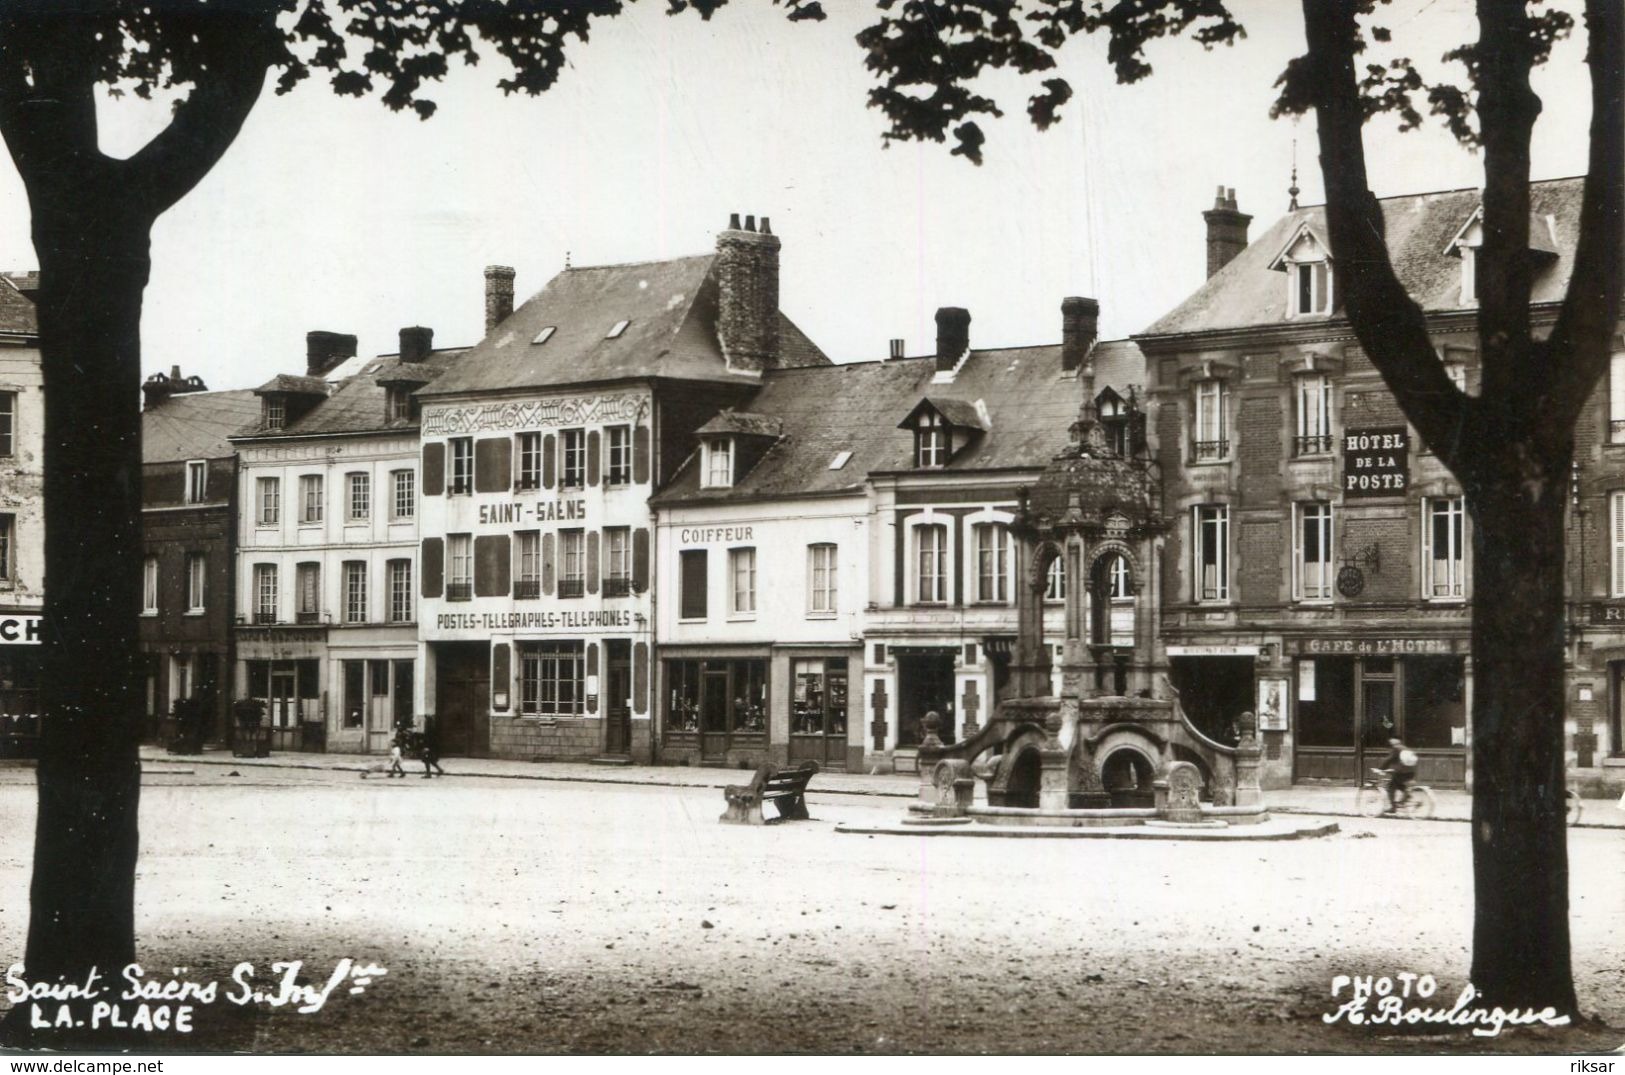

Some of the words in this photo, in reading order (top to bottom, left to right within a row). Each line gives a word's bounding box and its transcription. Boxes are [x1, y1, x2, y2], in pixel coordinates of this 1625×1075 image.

[1356, 457, 1372, 468] DE
[1378, 456, 1396, 467] LA
[1347, 474, 1404, 490] POSTE
[681, 526, 753, 544] COIFFEUR
[1358, 641, 1372, 651] de
